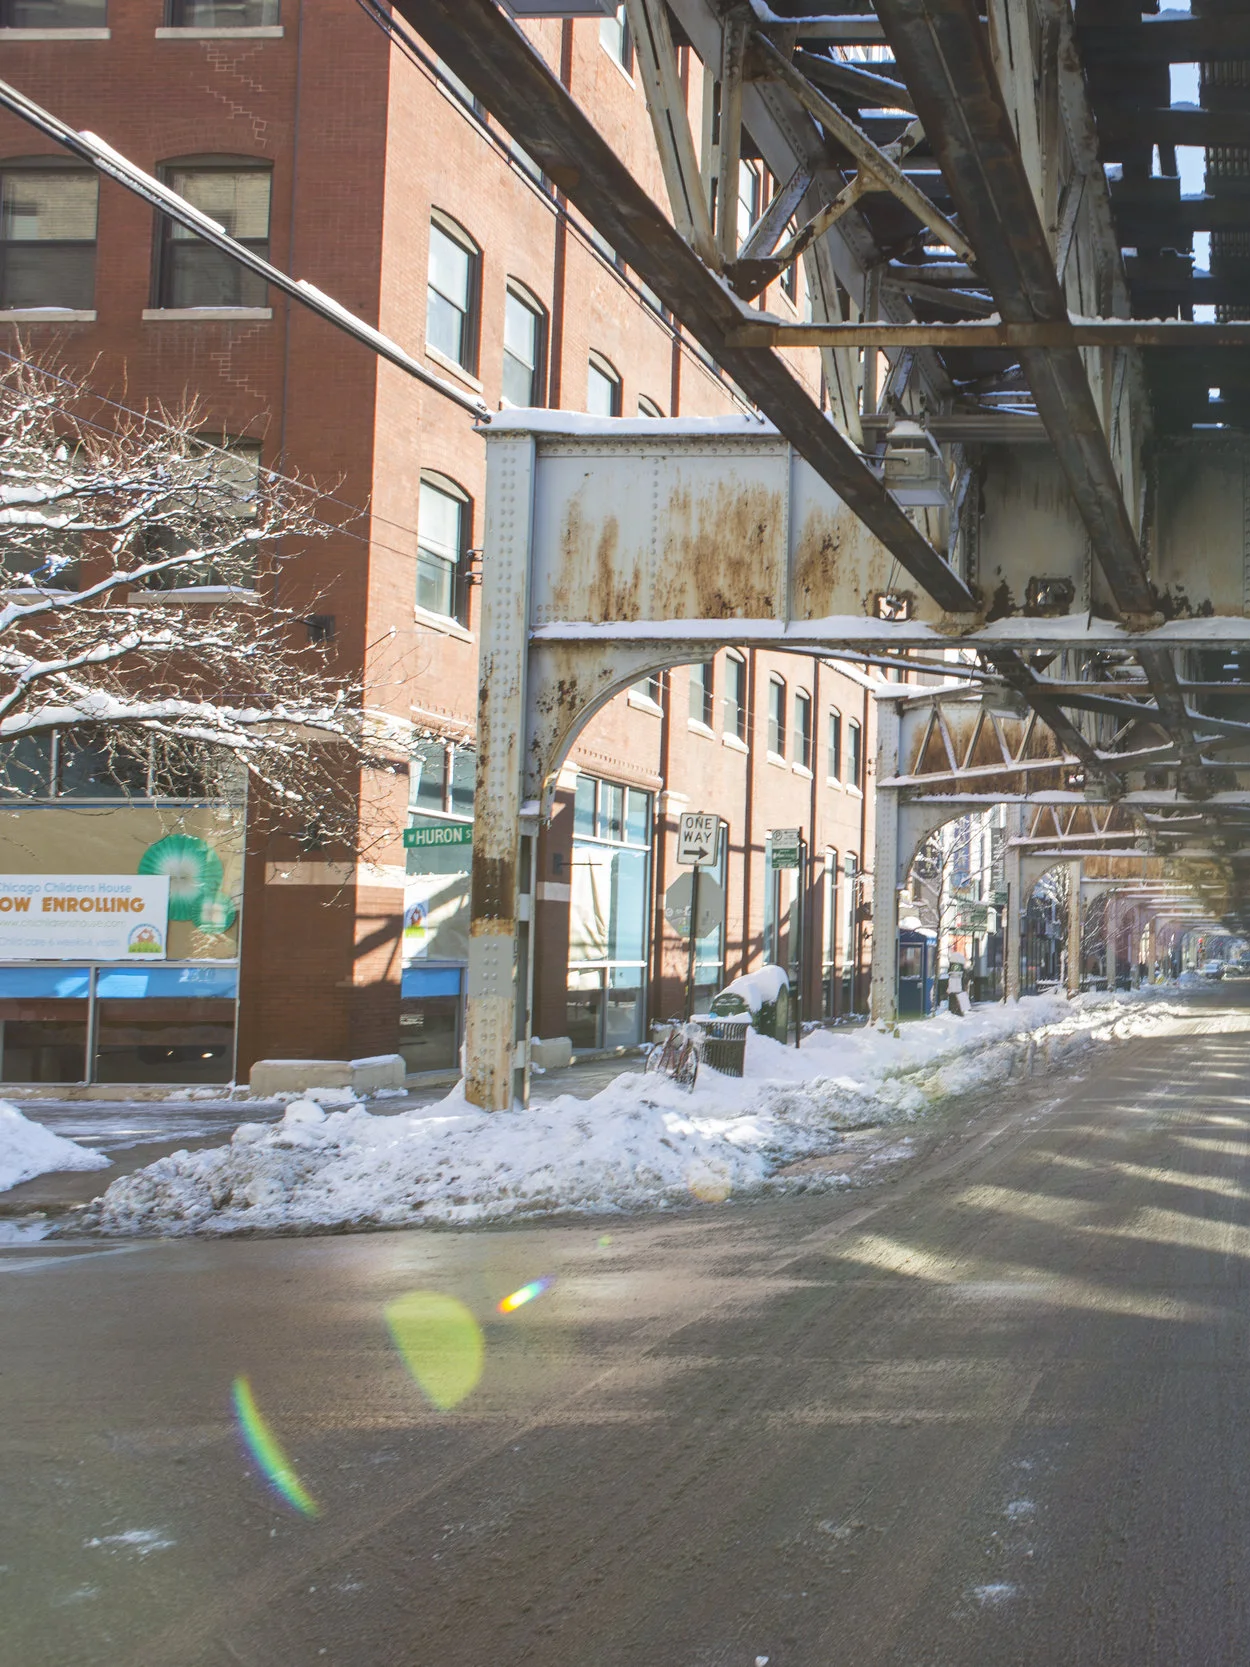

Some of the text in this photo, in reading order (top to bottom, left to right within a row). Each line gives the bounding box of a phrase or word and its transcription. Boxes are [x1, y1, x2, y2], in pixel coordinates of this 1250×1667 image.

[686, 817, 712, 829] ONE
[416, 828, 463, 845] HURON
[684, 831, 712, 843] WAY
[44, 882, 95, 893] Childrens
[98, 882, 132, 893] House
[42, 897, 145, 912] ENROLLING
